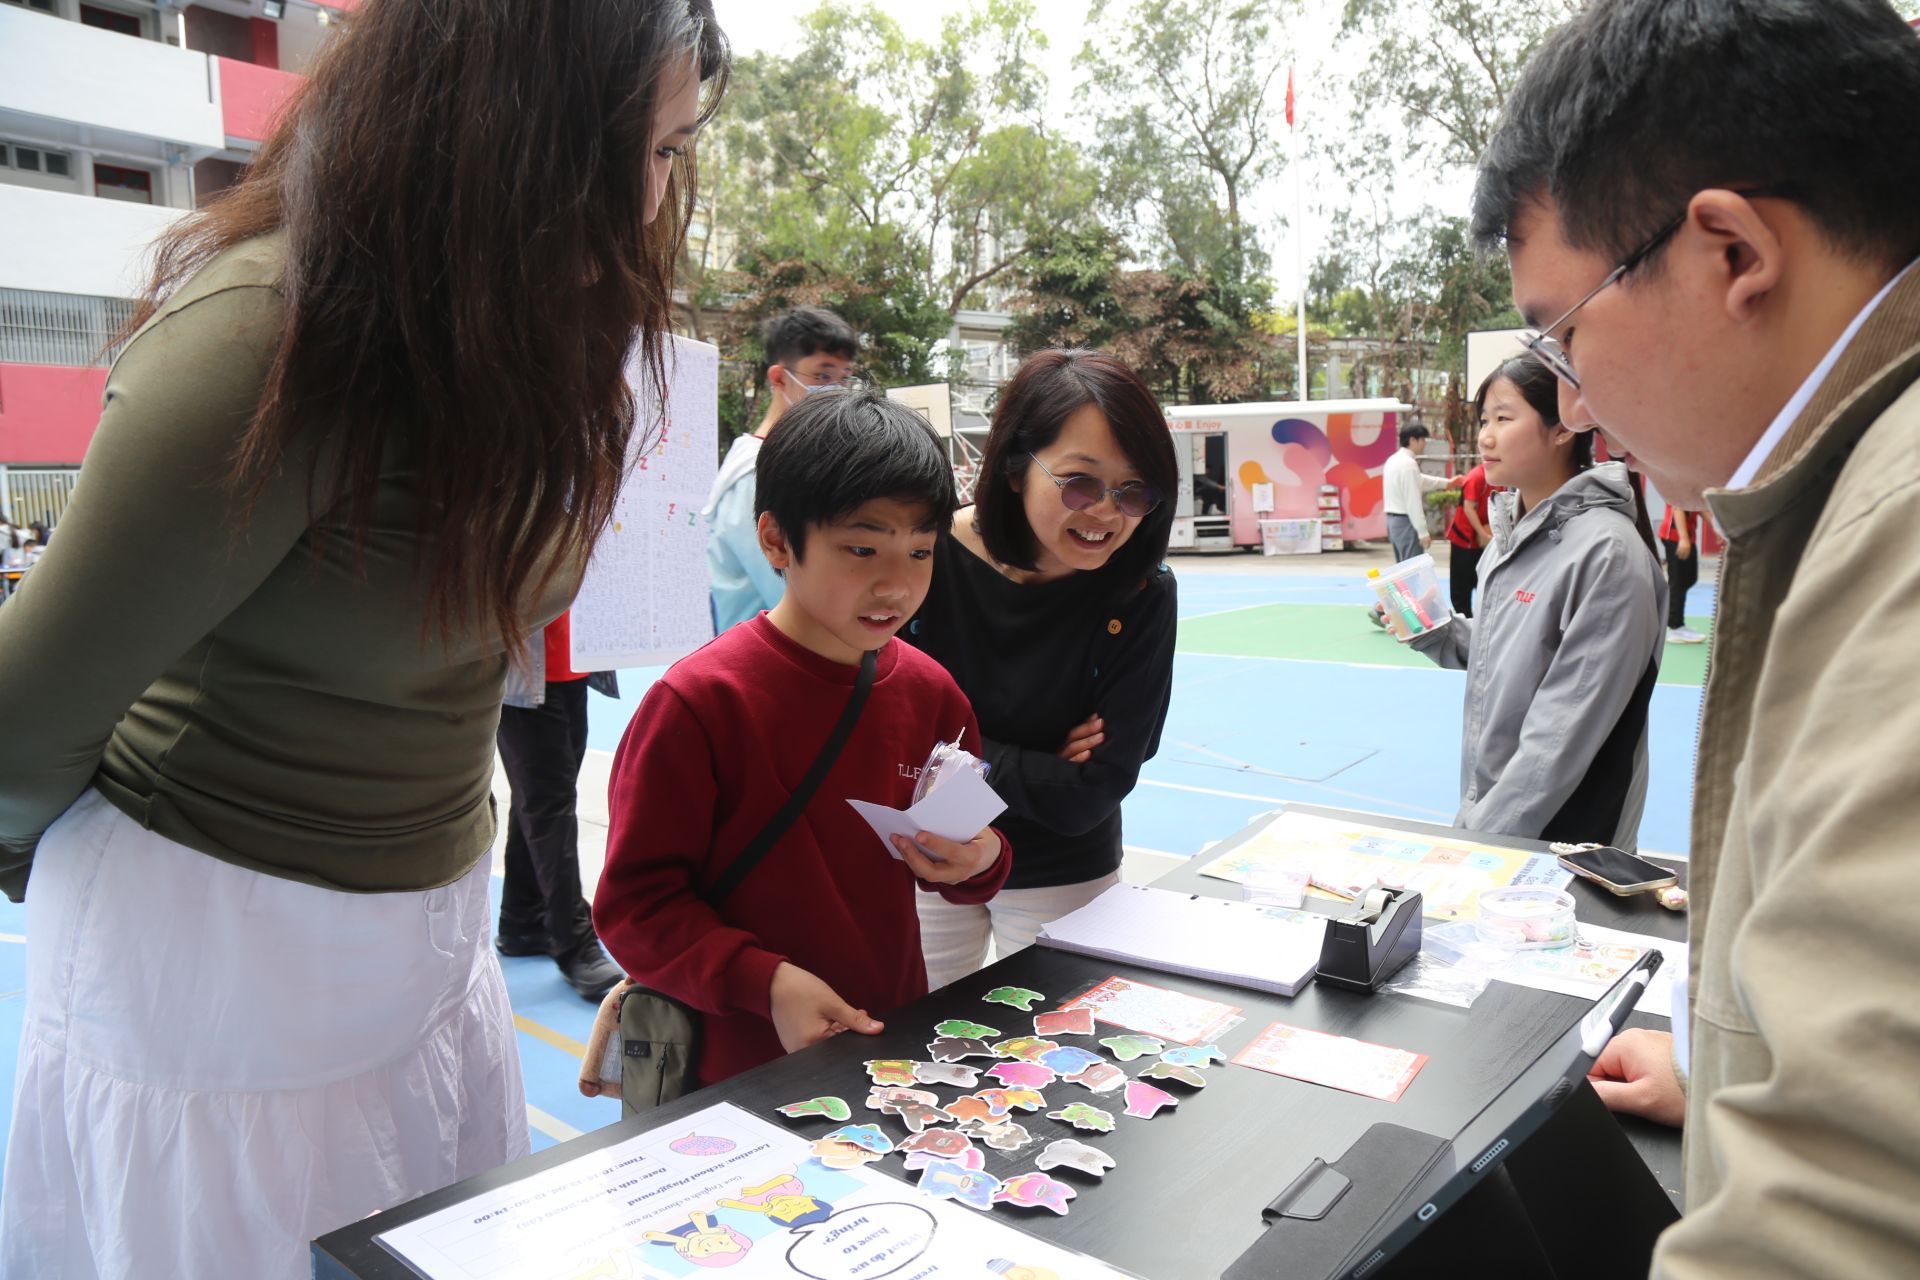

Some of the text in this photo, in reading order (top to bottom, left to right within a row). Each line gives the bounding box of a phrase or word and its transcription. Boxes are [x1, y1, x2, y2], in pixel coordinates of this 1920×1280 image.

[1197, 420, 1222, 430] Enjoy
[614, 1154, 646, 1171] Time:
[626, 1142, 771, 1208] Location: School Playground
[638, 1166, 667, 1182] Date:
[618, 1178, 639, 1191] 6th
[690, 1181, 724, 1201] English
[651, 1200, 684, 1218] chance
[642, 1213, 653, 1222] to
[842, 1228, 890, 1254] have to
[870, 1253, 886, 1261] do
[849, 1261, 870, 1274] we
